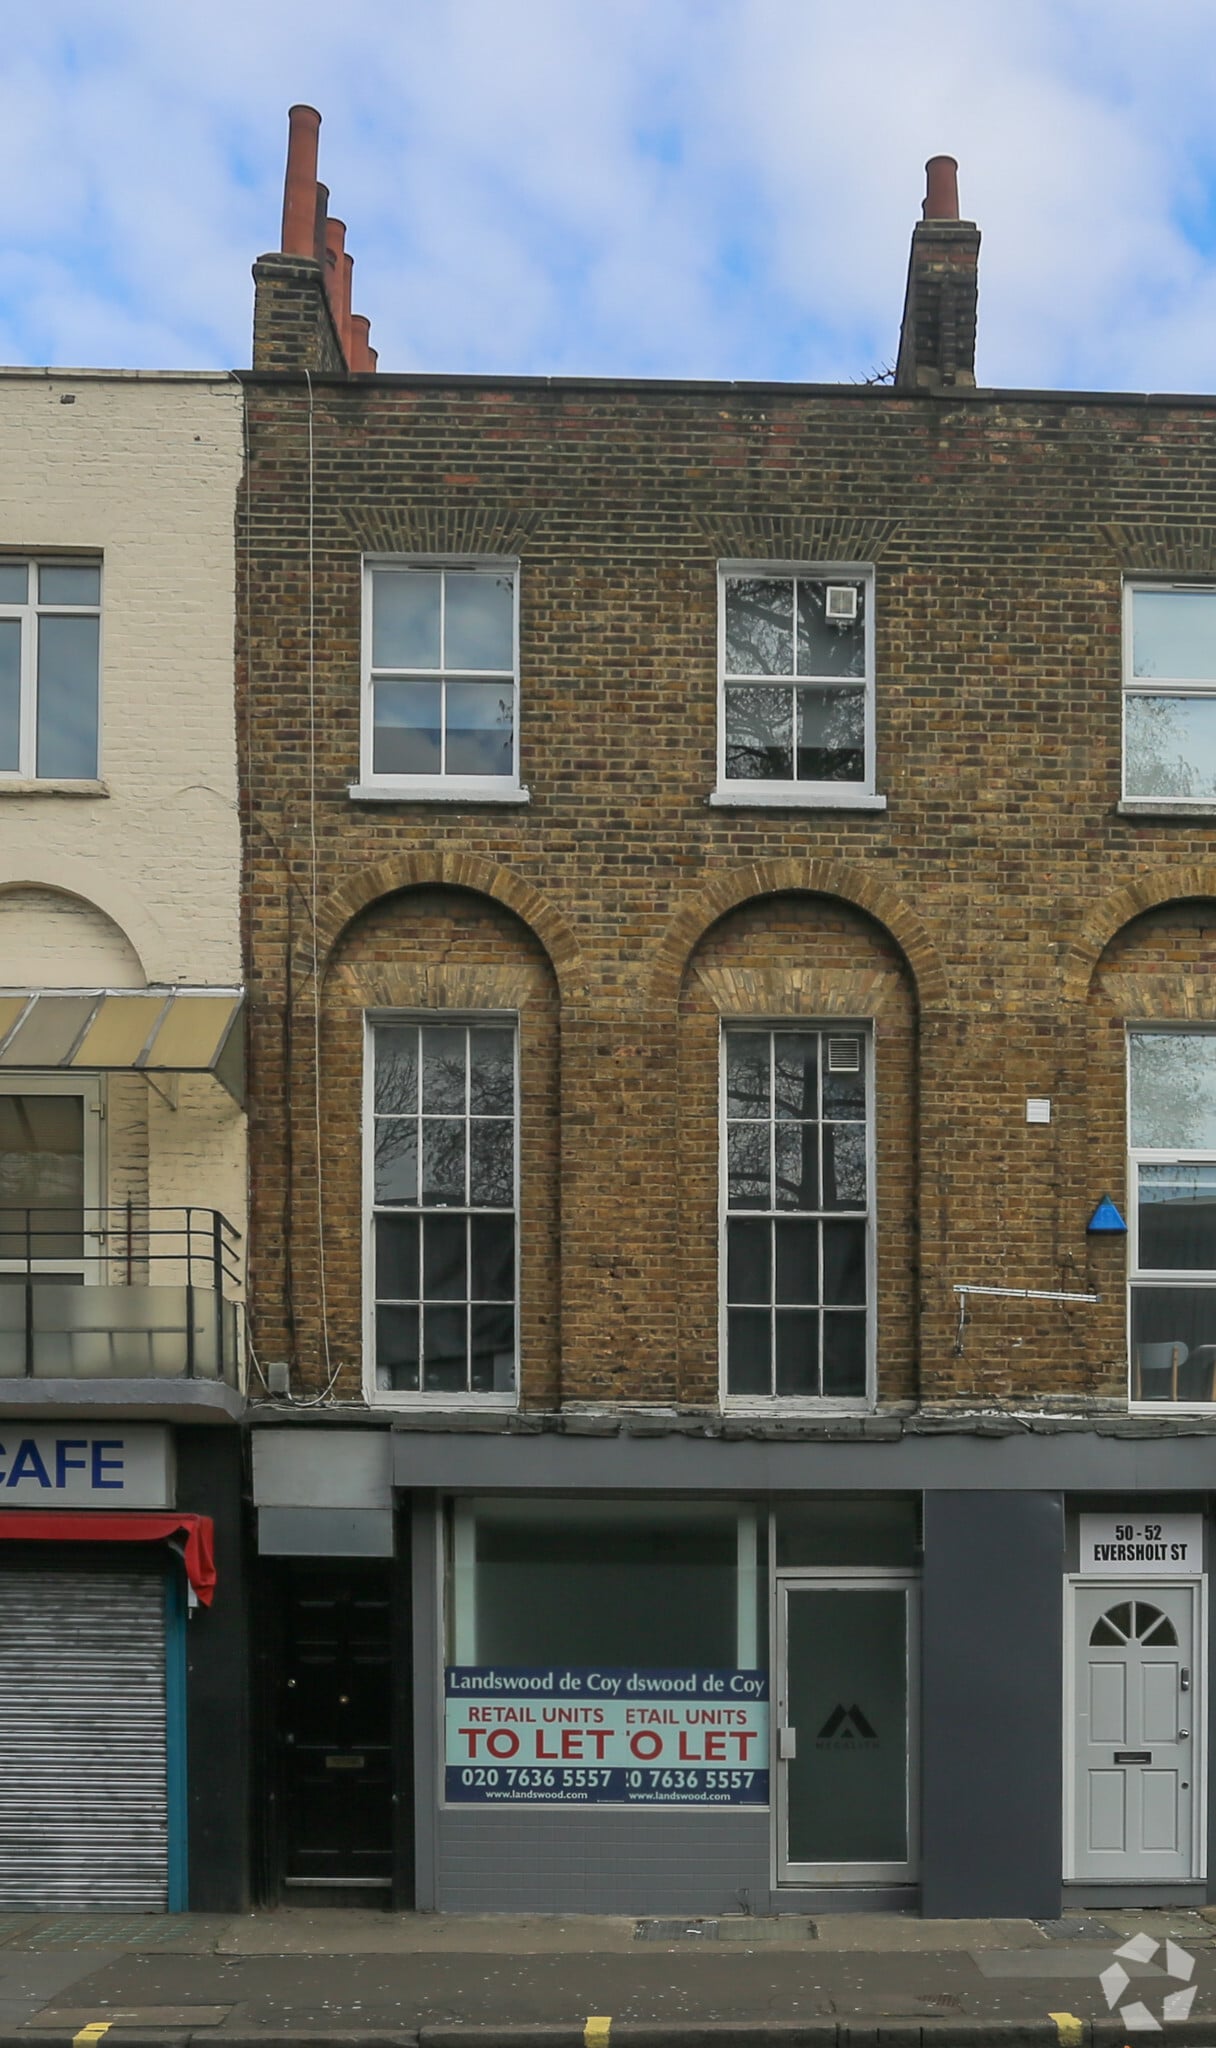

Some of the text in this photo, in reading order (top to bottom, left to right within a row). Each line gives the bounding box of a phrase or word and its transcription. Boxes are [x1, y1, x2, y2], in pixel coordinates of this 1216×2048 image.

[0, 1439, 124, 1489] AFE
[1115, 1525, 1134, 1541] 50
[1144, 1525, 1162, 1541] 52
[1094, 1544, 1188, 1561] EVERSHOLT ST
[450, 1671, 622, 1696] Landswood de Coy
[626, 1673, 765, 1698] dswood de Coy
[469, 1706, 604, 1723] RETAIL UNITS
[685, 1709, 747, 1725] UNITS
[458, 1728, 615, 1760] TO LET
[626, 1730, 758, 1761] O LET
[461, 1768, 612, 1787] 020 7636 5557
[649, 1771, 698, 1788] 7636
[705, 1771, 755, 1789] 5557
[485, 1790, 588, 1800] www.landswood.com
[629, 1791, 731, 1802] www.landswood.com
